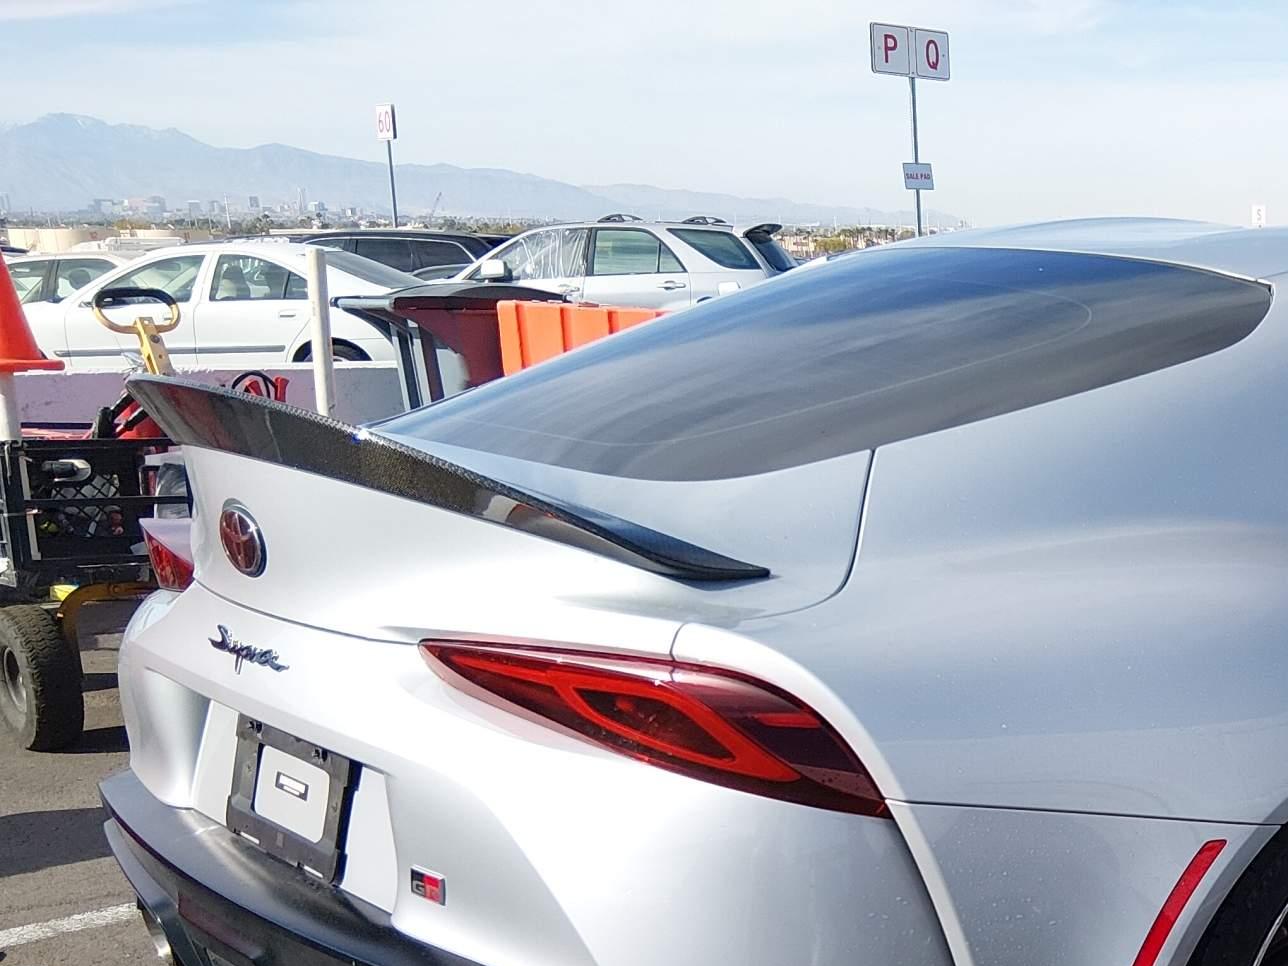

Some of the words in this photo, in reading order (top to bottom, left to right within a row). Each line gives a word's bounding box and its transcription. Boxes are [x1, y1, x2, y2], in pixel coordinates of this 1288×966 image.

[884, 34, 897, 63] P
[926, 39, 939, 70] Q
[378, 110, 391, 133] 60
[207, 624, 290, 675] Supra
